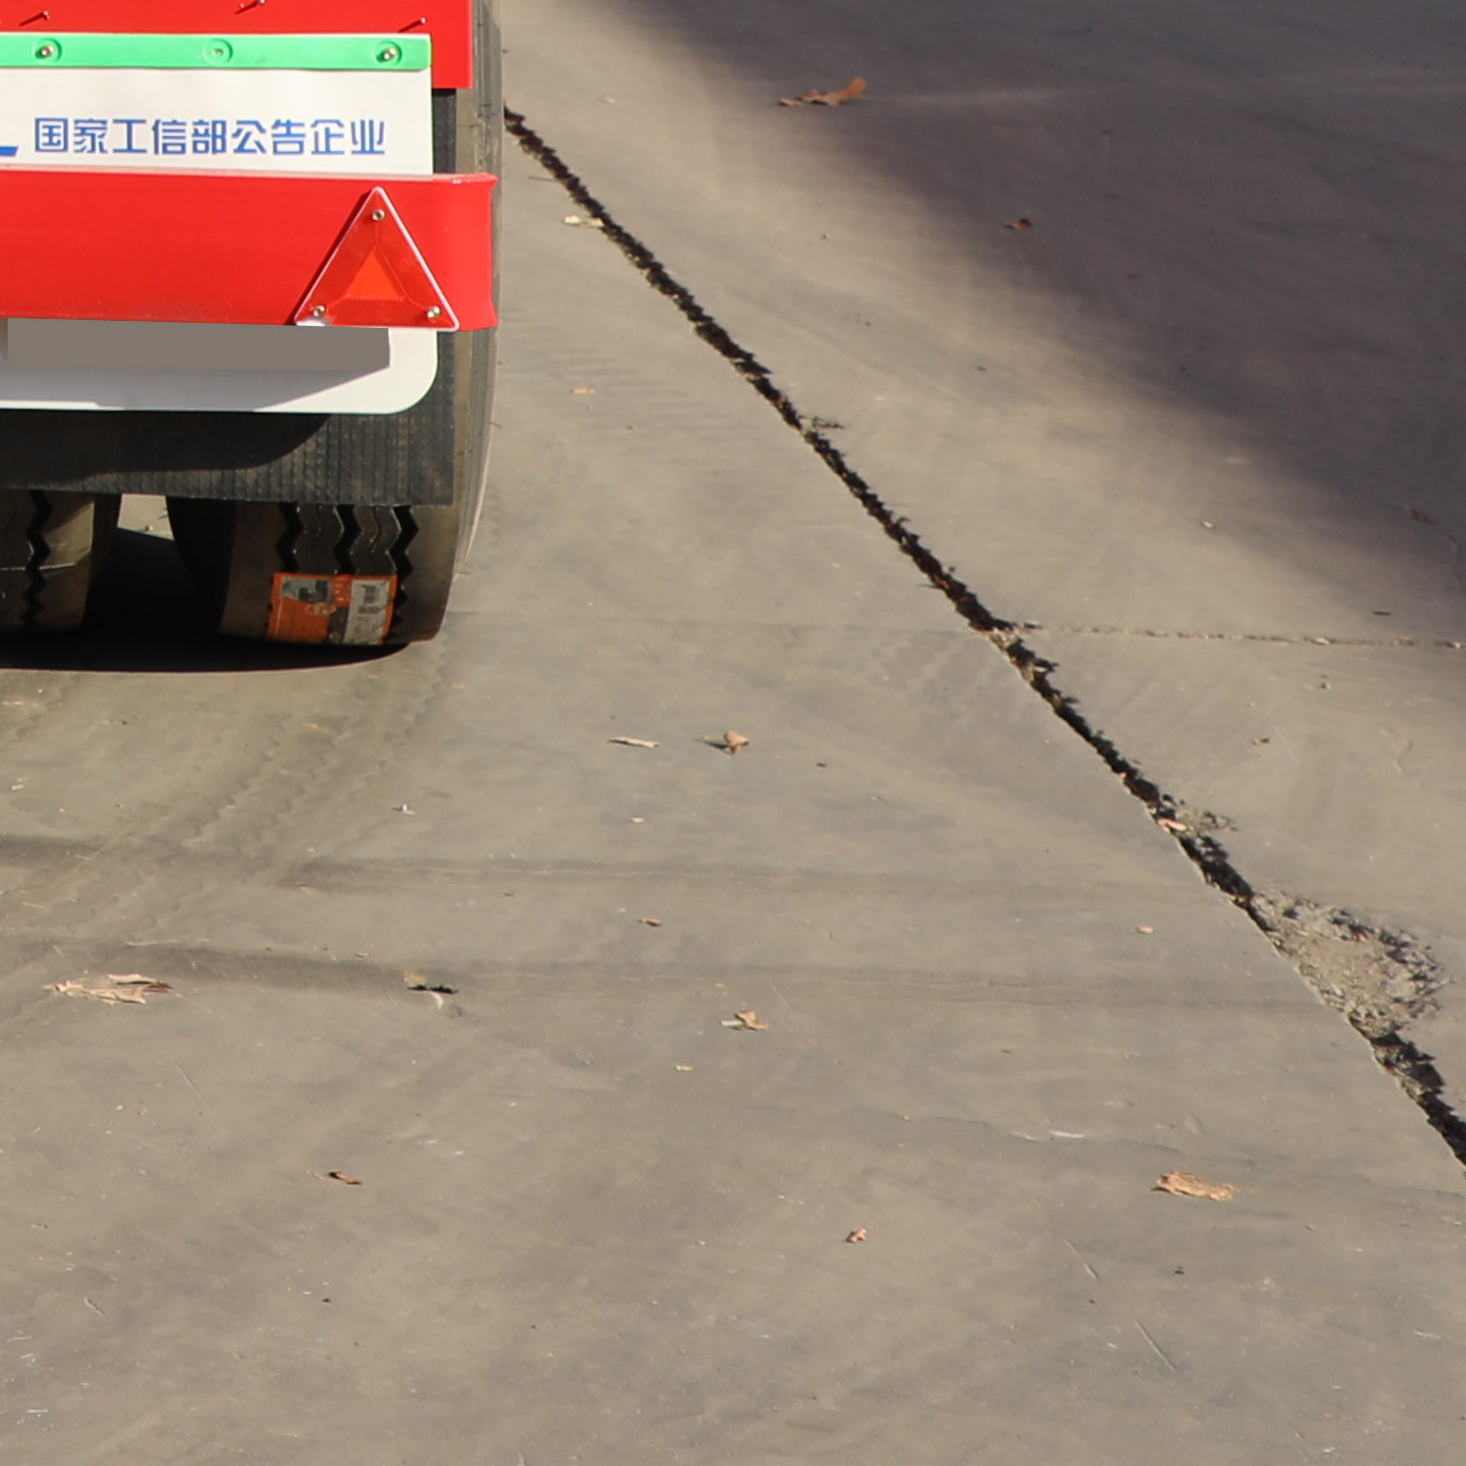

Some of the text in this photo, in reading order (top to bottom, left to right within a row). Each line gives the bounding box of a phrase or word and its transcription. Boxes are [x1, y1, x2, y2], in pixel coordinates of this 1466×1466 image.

[34, 117, 386, 156] 国家工信部公告企业
